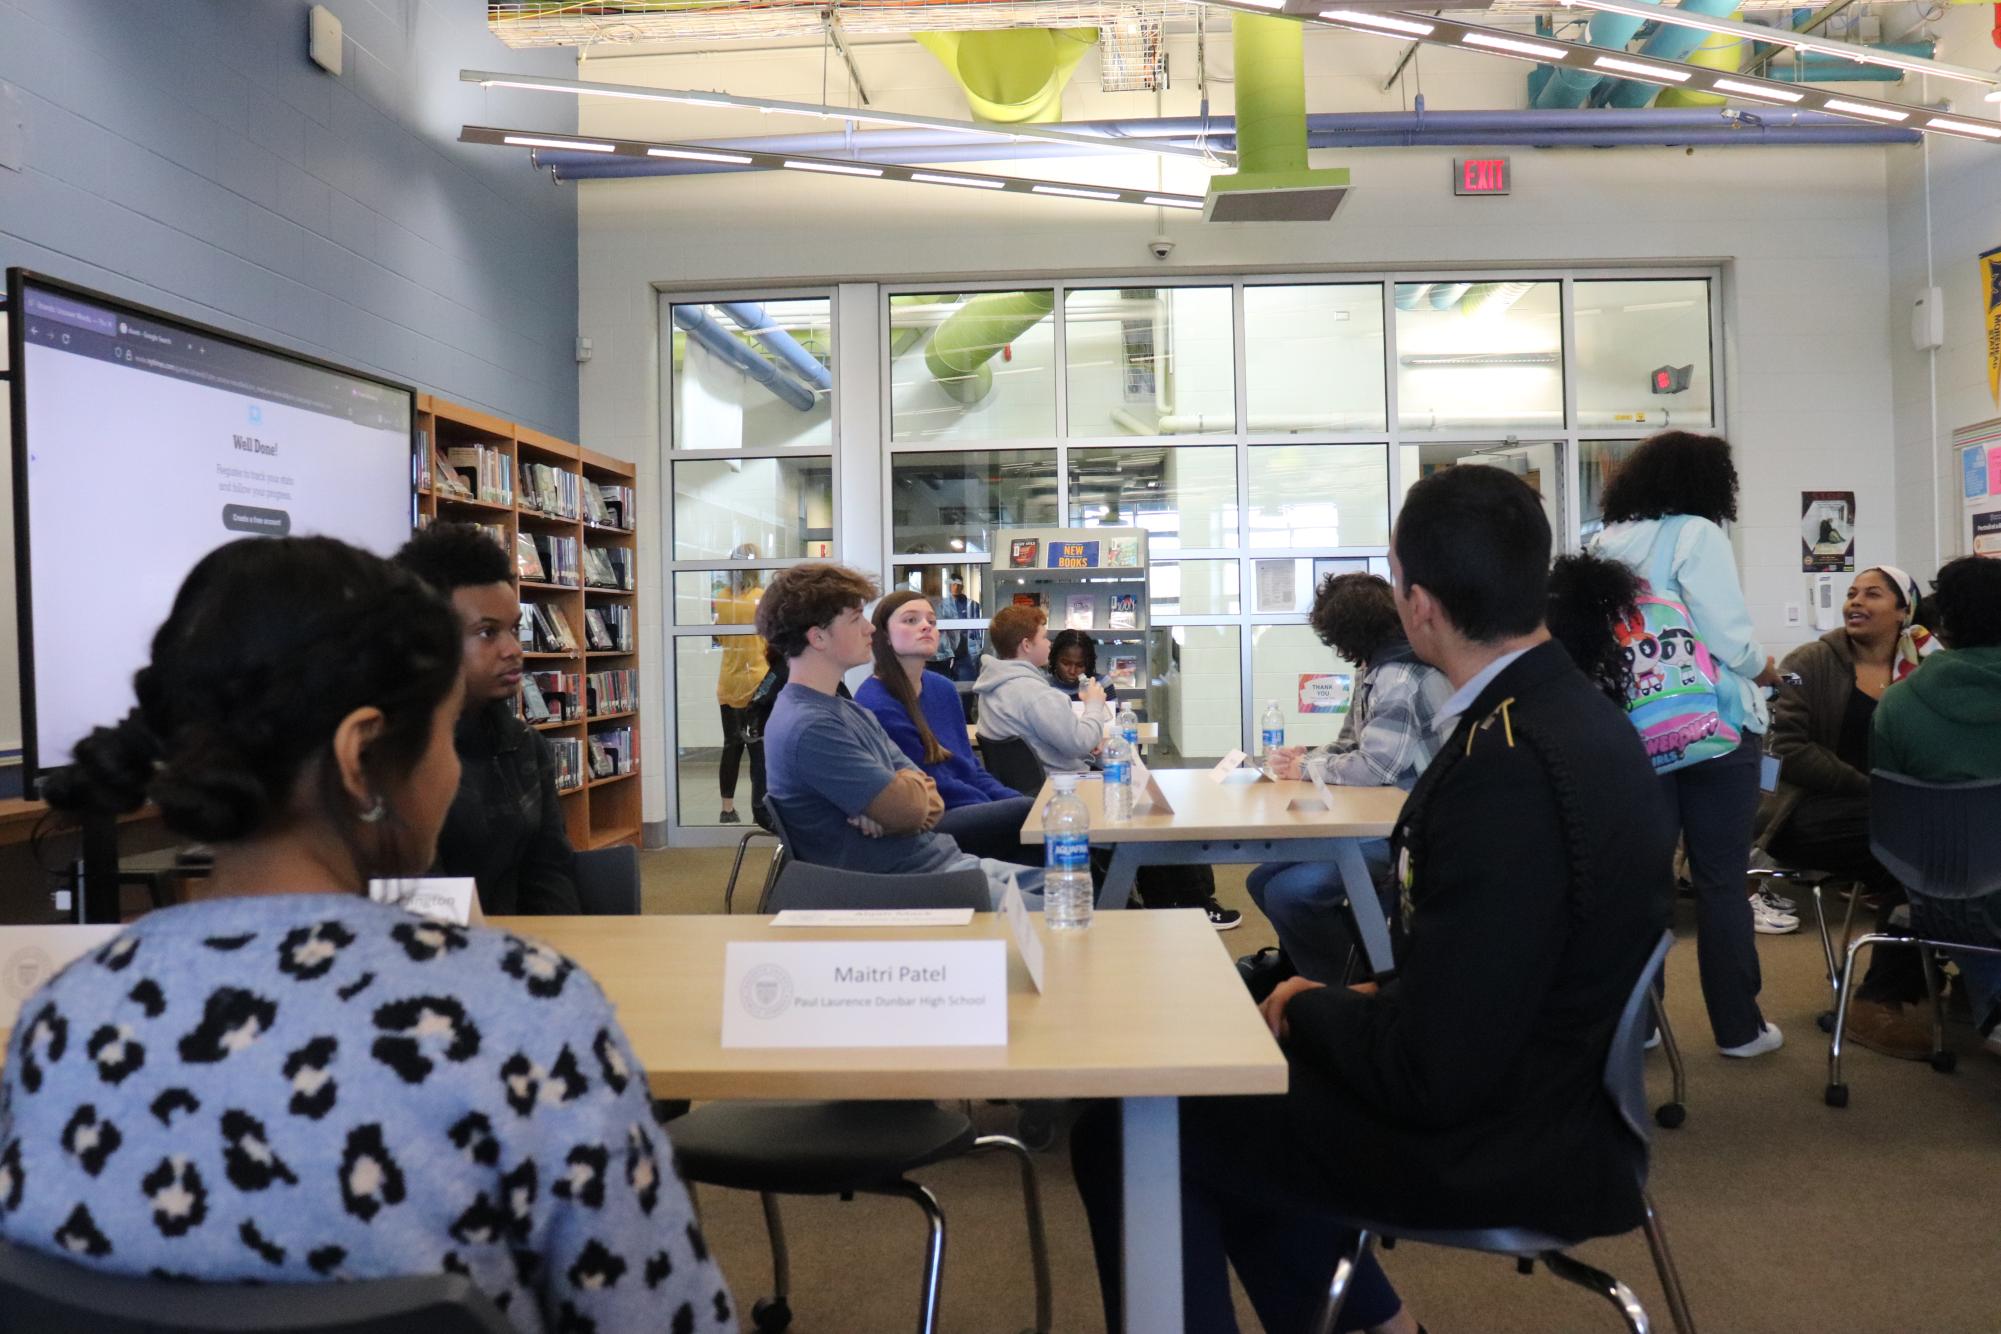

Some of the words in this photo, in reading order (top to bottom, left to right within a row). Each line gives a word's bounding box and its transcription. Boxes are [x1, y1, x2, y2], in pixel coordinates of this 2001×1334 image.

[1463, 159, 1505, 191] EXIT
[232, 434, 253, 452] Well
[254, 438, 279, 456] Done!
[1064, 545, 1084, 556] NEW
[1058, 557, 1088, 568] BOOKS
[834, 966, 893, 983] Maitri
[899, 966, 947, 982] Patel
[794, 996, 818, 1008] Paul
[820, 996, 872, 1008] Laurence
[875, 996, 916, 1007] Dunbar
[919, 995, 946, 1009] High
[948, 995, 986, 1007] School
